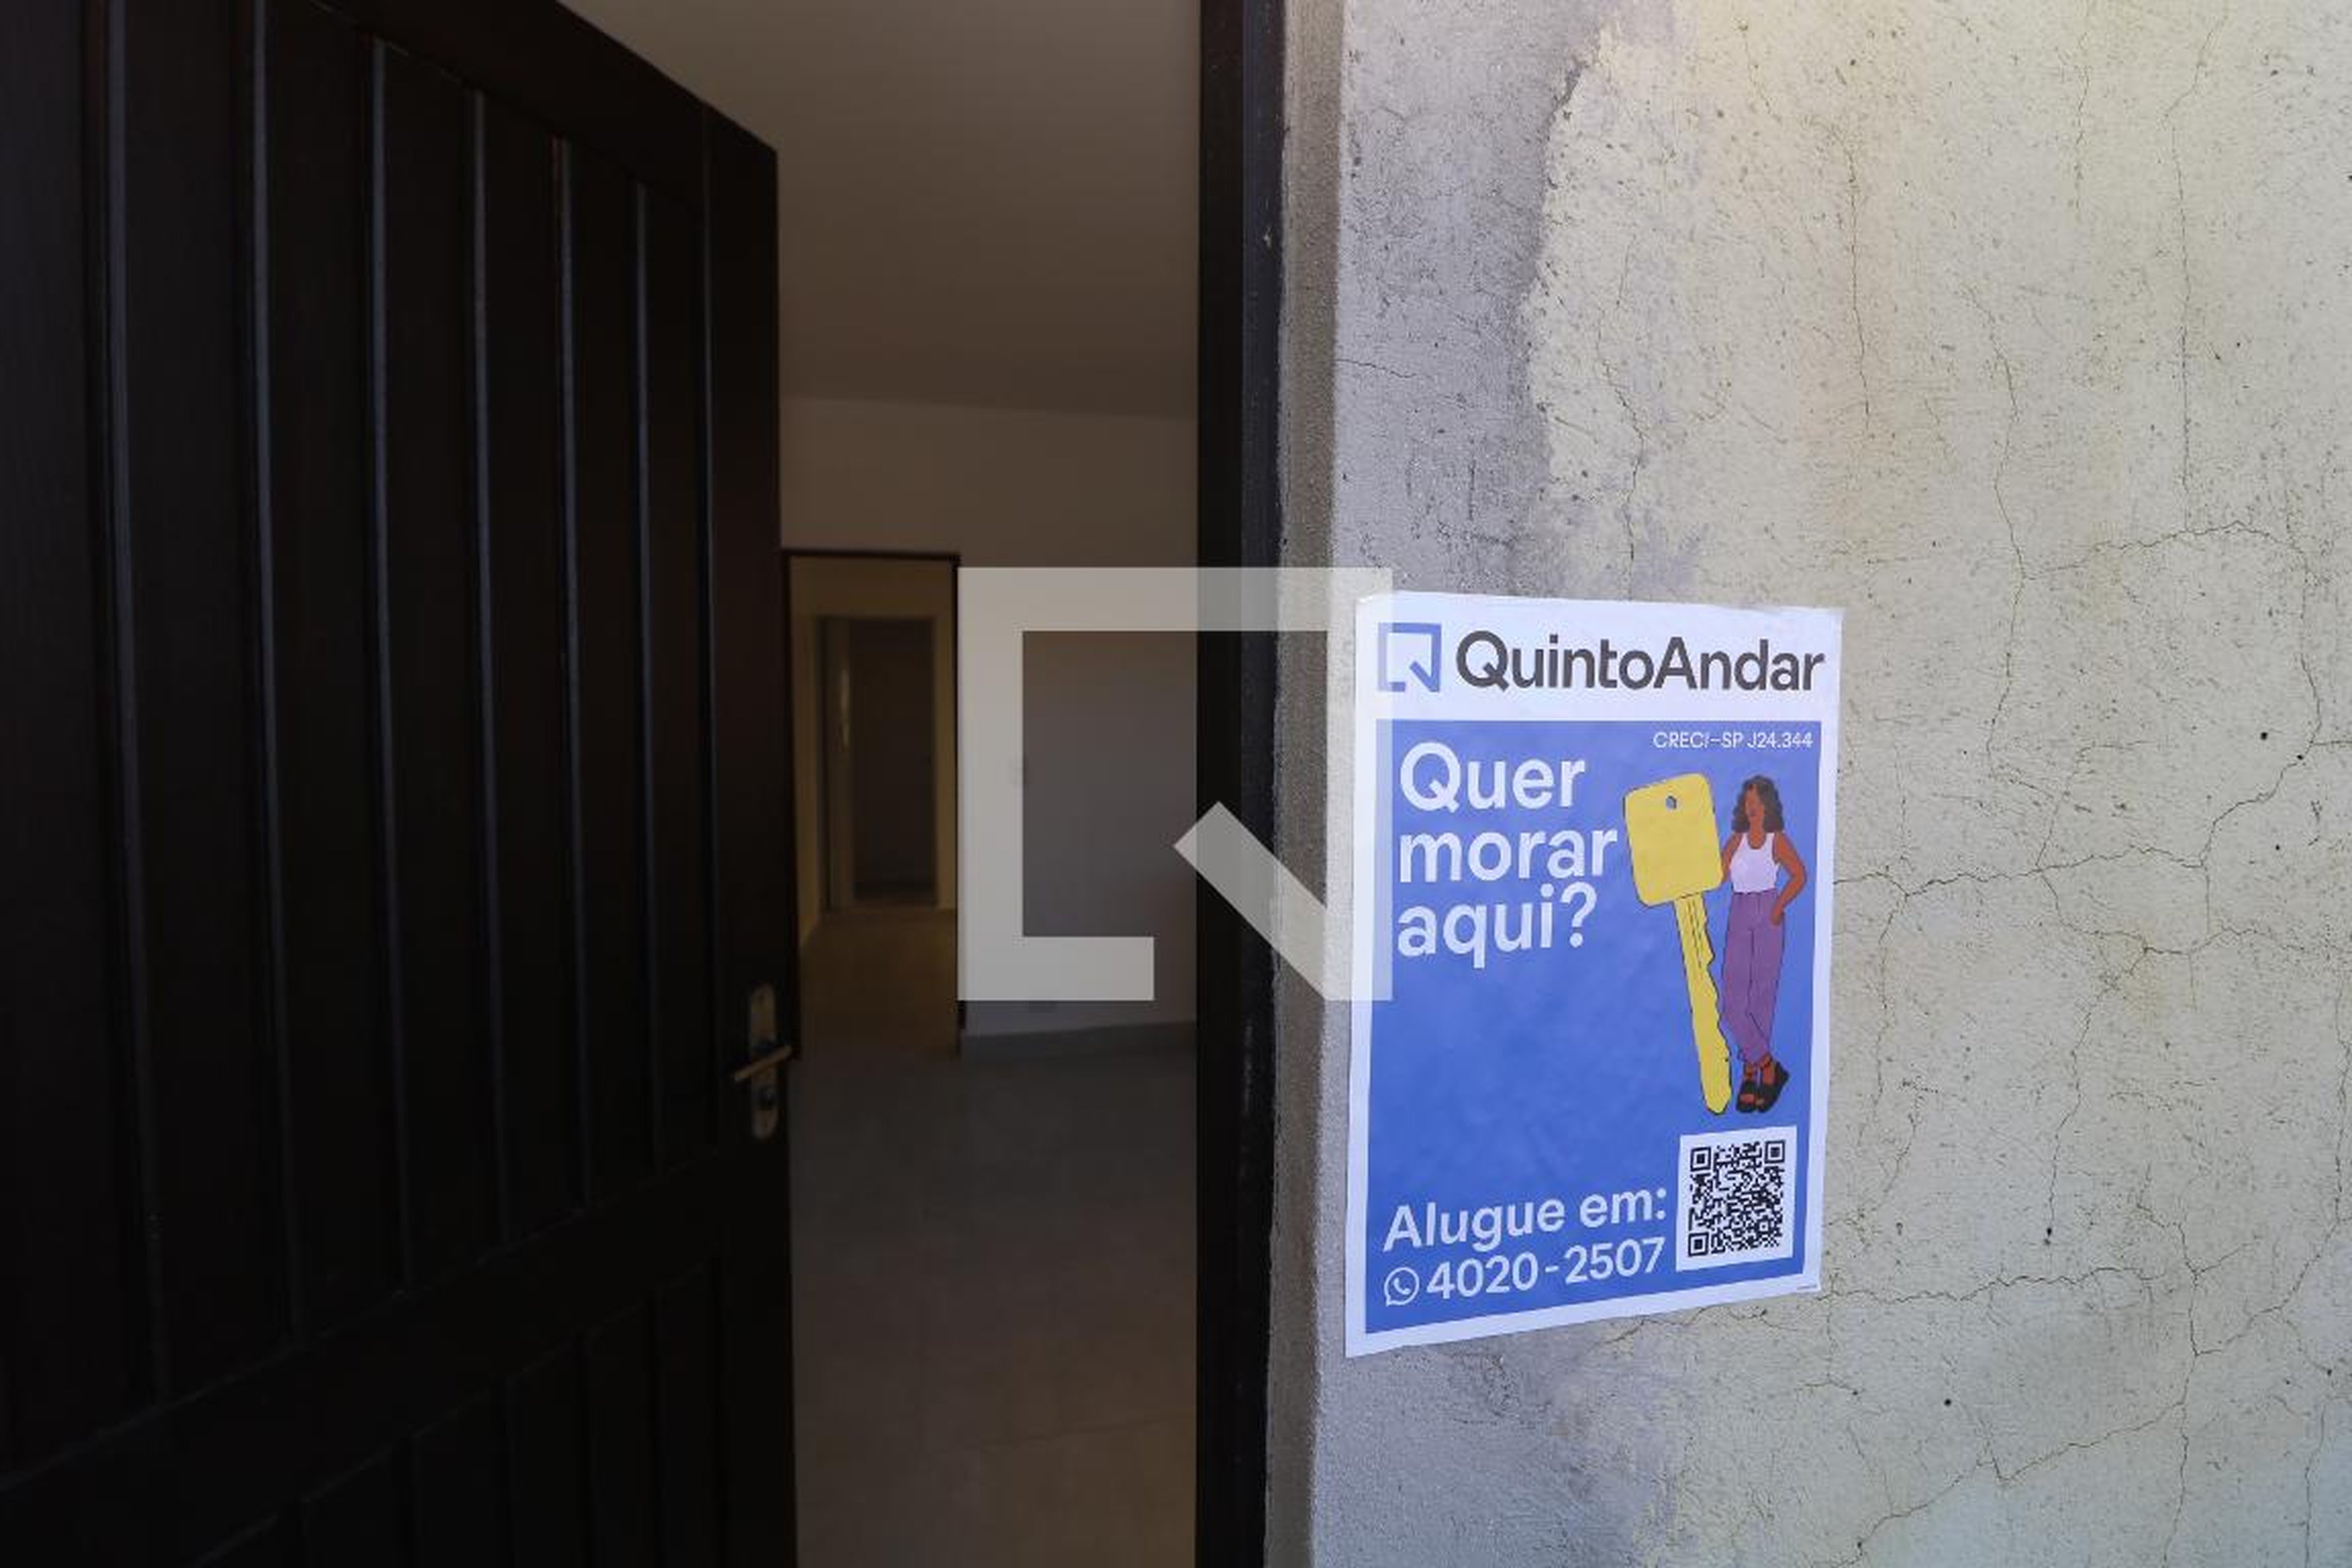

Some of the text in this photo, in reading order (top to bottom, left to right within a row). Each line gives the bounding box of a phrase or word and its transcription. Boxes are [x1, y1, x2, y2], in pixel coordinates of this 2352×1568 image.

[1456, 631, 1825, 691] QuintoAndar
[1747, 731, 1814, 748] J24.344
[1401, 742, 1586, 812] Quer
[1400, 829, 1618, 883] morar
[1398, 882, 1597, 968] aqui?
[1382, 1187, 1667, 1253] Alugue em:
[1426, 1237, 1665, 1299] 4020-2507
